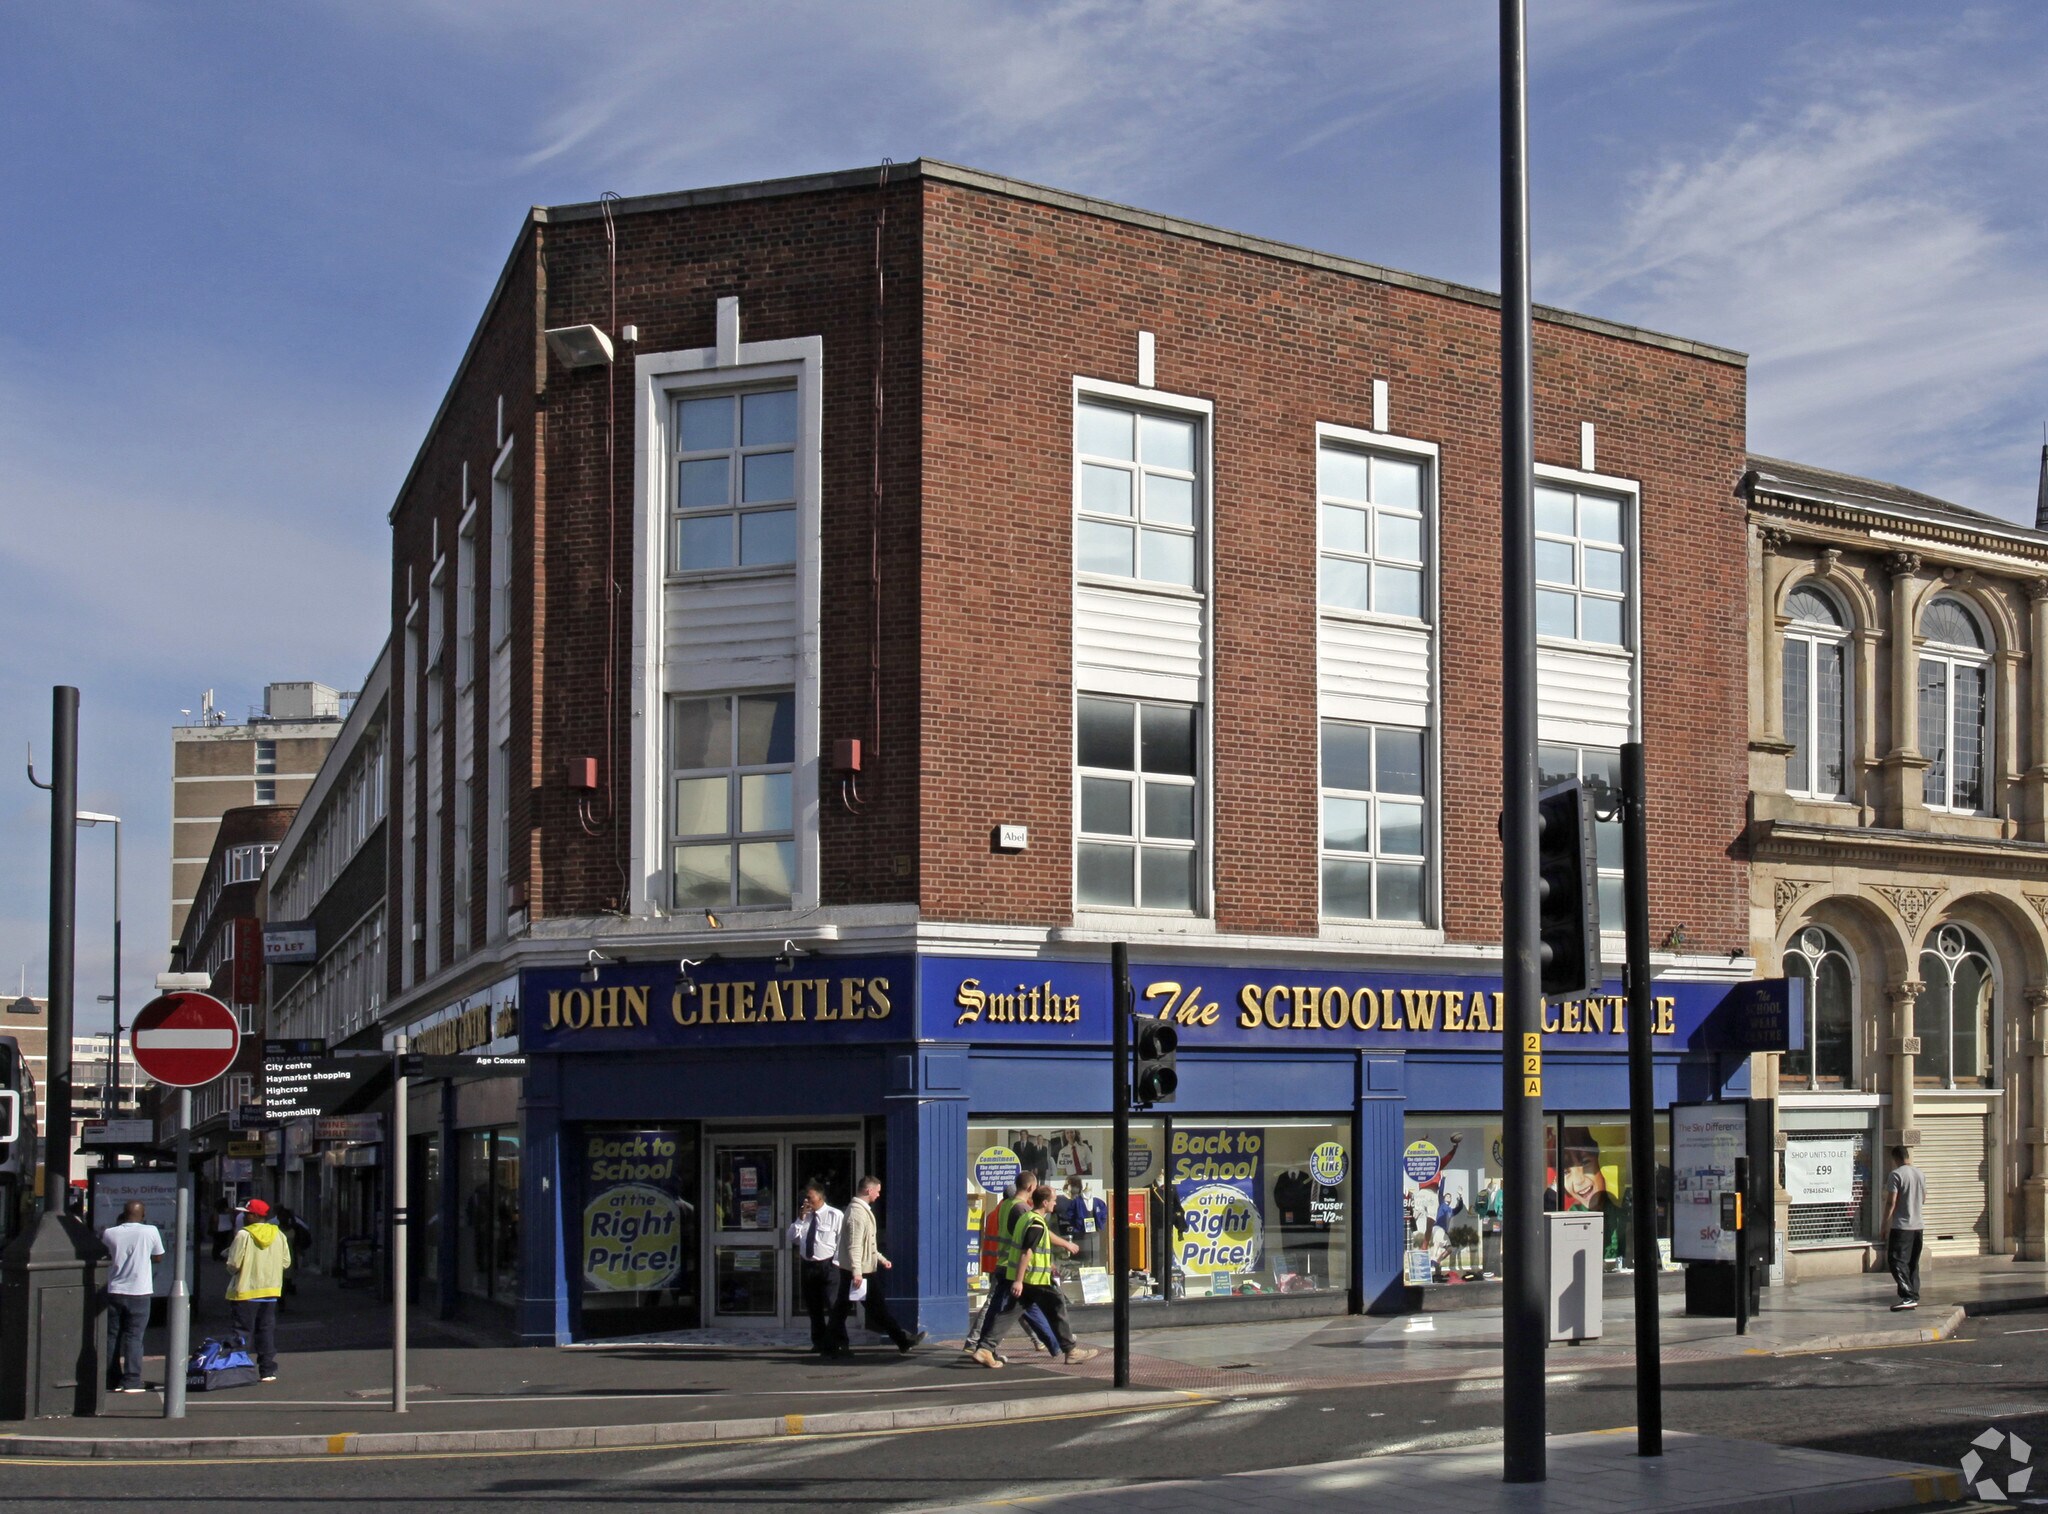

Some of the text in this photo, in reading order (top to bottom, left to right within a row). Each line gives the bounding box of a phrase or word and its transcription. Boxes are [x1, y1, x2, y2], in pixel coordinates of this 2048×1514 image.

[1003, 832, 1025, 842] Abel
[266, 942, 305, 952] TO LET
[543, 977, 892, 1030] JOHN CHEATLES
[957, 978, 1080, 1025] Smiths
[1146, 981, 1220, 1026] The
[1541, 994, 1675, 1034] CENTE
[265, 1062, 312, 1071] City centre
[476, 1057, 492, 1065] Age
[266, 1071, 351, 1083] Haymarket shopping
[266, 1086, 308, 1095] Highcross
[266, 1098, 296, 1106] Market
[266, 1108, 321, 1118] Shopmobility
[1679, 1122, 1745, 1133] The Sky Difference
[588, 1136, 676, 1158] Back to
[1171, 1130, 1261, 1155] Back to
[1321, 1146, 1340, 1156] LIKE
[1791, 1151, 1809, 1159] SHOP
[1837, 1150, 1847, 1158] LET
[590, 1158, 673, 1181] School
[1173, 1156, 1258, 1181] School
[1321, 1162, 1340, 1171] LIKE
[1816, 1165, 1832, 1175] £99
[121, 1186, 138, 1195] Sky
[610, 1193, 656, 1207] at the
[1199, 1193, 1235, 1205] at the
[1323, 1211, 1336, 1223] 1/2
[590, 1209, 676, 1243] Right
[1184, 1208, 1251, 1239] Right
[1700, 1226, 1721, 1244] sky
[587, 1245, 678, 1273] Price!
[1181, 1240, 1253, 1266] Price!
